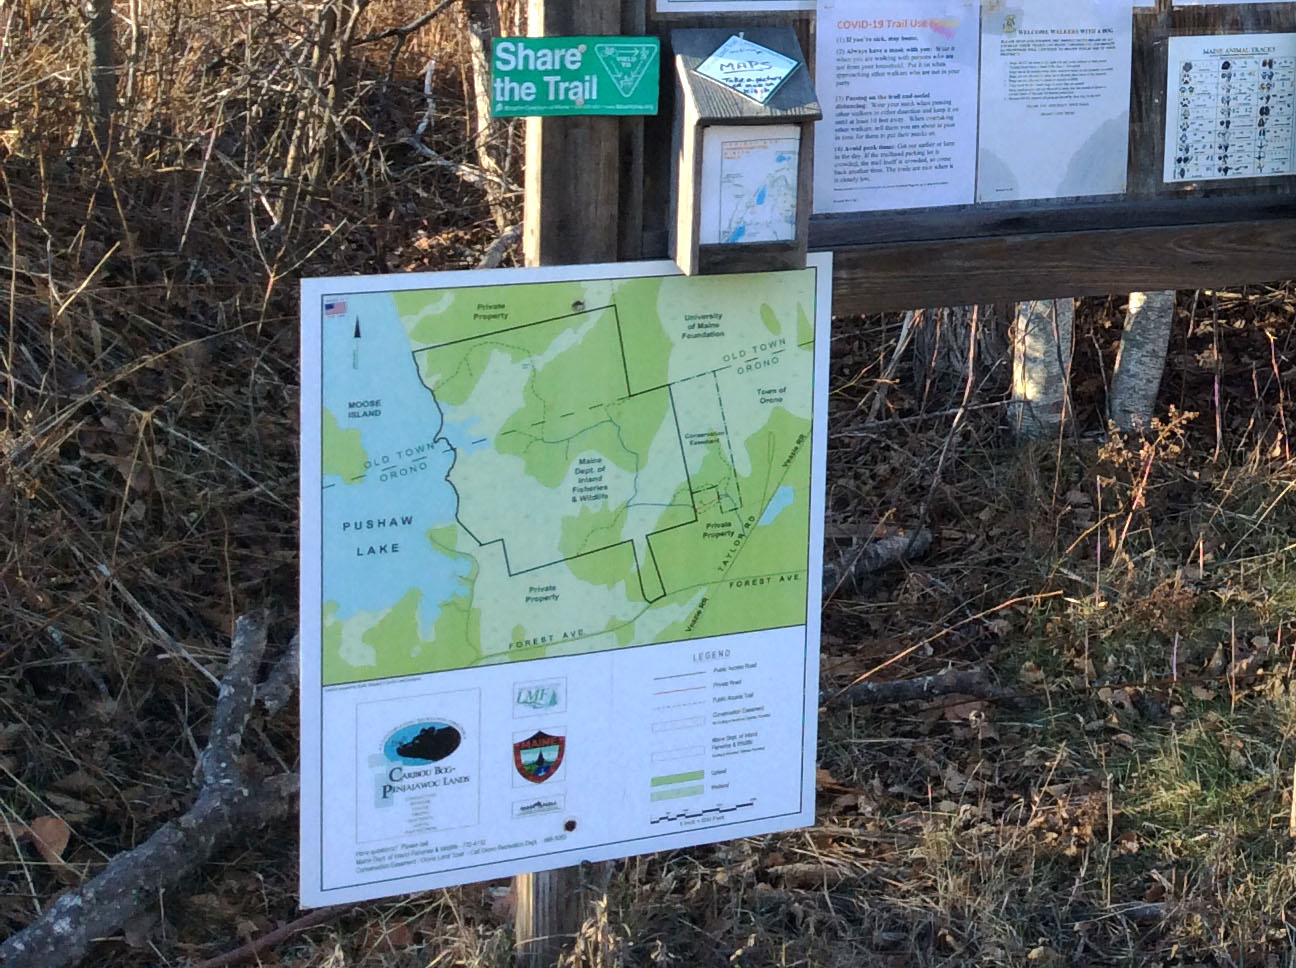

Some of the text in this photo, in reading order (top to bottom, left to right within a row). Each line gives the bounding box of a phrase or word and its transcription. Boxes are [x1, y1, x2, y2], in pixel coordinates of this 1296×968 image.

[836, 19, 884, 30] COVID-19
[886, 18, 908, 29] Trail
[909, 18, 929, 29] Use
[847, 47, 868, 55] Always
[868, 46, 883, 54] have
[905, 45, 919, 54] with
[495, 41, 583, 72] Share
[719, 60, 773, 72] MAPS
[494, 74, 598, 102] the Trail
[476, 302, 507, 311] Private
[472, 312, 509, 324] Property
[684, 312, 723, 324] University
[687, 322, 721, 331] of Maine
[681, 330, 726, 340] Foundation
[722, 338, 787, 364] OLD TOWN
[736, 356, 780, 376] ORONO
[756, 385, 787, 396] Town of
[347, 399, 382, 409] MOOSE
[758, 395, 784, 405] Orono
[347, 409, 382, 419] ISLAND
[363, 442, 437, 471] OLD TOWN
[578, 457, 603, 466] Maine
[378, 461, 429, 482] ORONO
[574, 465, 606, 476] Dept. of
[577, 475, 603, 485] Inland
[572, 484, 609, 496] Fisheries
[579, 493, 609, 503] Wildlife
[341, 515, 414, 532] PUSHAW
[705, 521, 733, 530] Private
[702, 530, 736, 540] Property
[356, 542, 401, 557] LAKE
[717, 515, 756, 573] TAYLOR RD
[528, 584, 558, 593] Private
[729, 577, 771, 589] FOREST
[524, 593, 560, 604] Property
[508, 634, 554, 650] FOREST
[692, 648, 732, 663] LEGEND
[520, 735, 563, 749] MAINE
[389, 765, 457, 783] CARIBOU BOG-
[442, 775, 471, 786] LANDS
